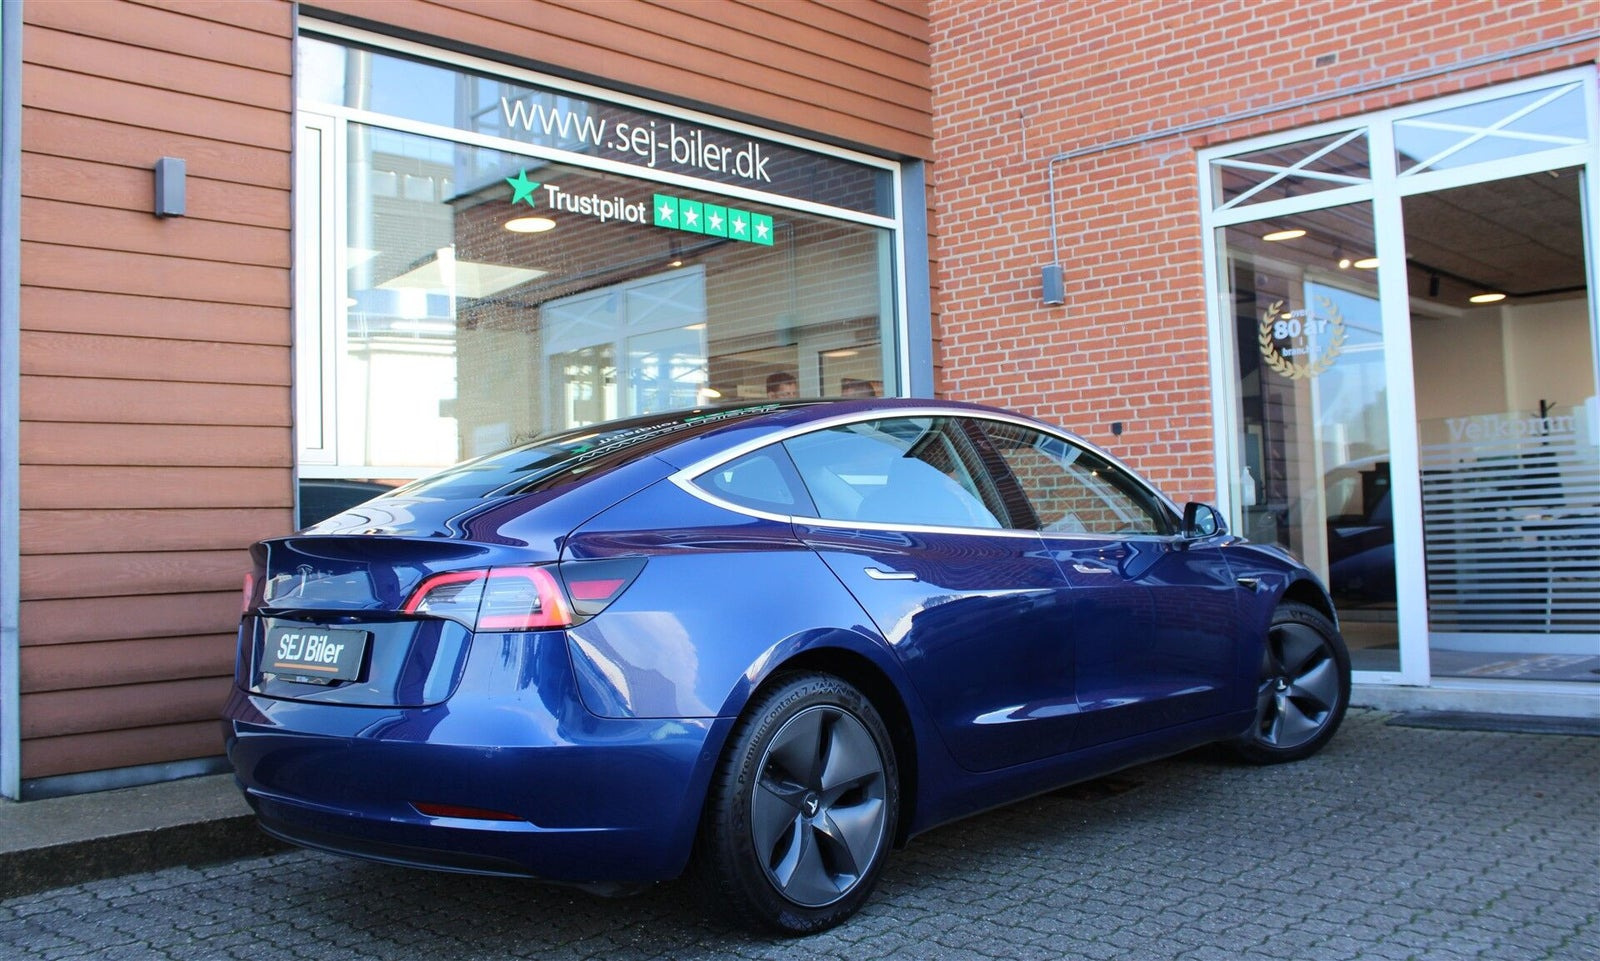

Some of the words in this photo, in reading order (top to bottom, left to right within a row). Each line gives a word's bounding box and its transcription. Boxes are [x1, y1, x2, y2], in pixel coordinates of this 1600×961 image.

[501, 96, 771, 182] www.sej-biler.dk
[543, 183, 646, 224] Trustpilot
[1273, 319, 1301, 340] 80
[277, 633, 306, 660] SEJ
[304, 635, 344, 663] Biler
[738, 689, 801, 784] PremiumContact
[801, 686, 809, 697] 7
